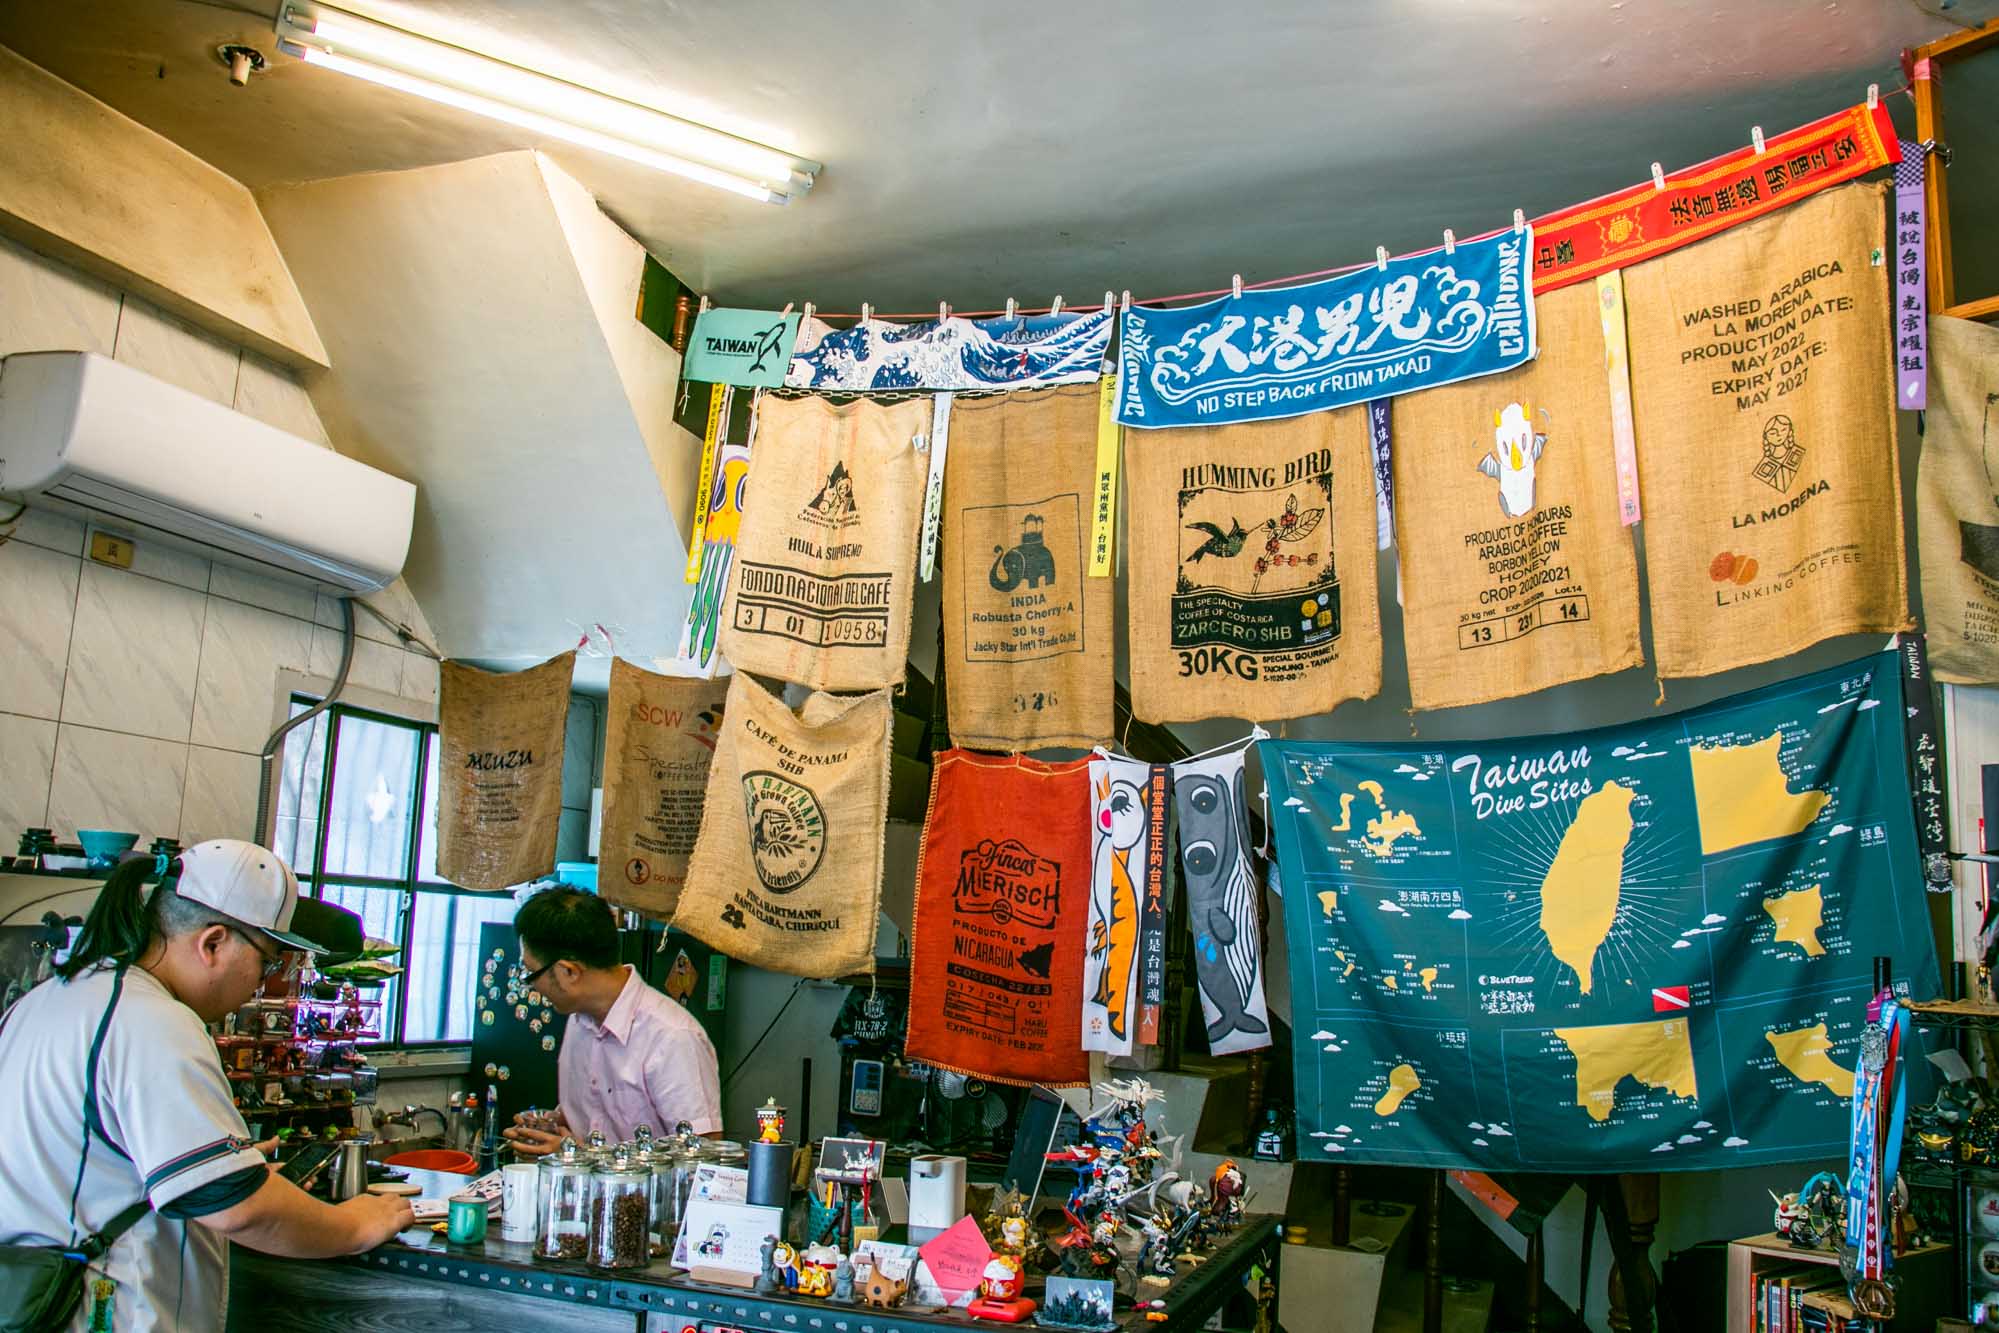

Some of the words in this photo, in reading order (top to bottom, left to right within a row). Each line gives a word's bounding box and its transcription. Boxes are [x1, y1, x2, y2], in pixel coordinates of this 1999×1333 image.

[1683, 299, 1761, 327] WASHED
[1769, 260, 1843, 307] ARABICA
[1193, 274, 1432, 376] 大港男兒
[1713, 322, 1737, 336] LA
[1745, 289, 1813, 332] MORENA
[706, 338, 757, 353] TAIWAN
[1681, 318, 1796, 364] PRODUCTION
[1801, 296, 1854, 324] DATE:
[1901, 295, 1923, 371] 光宗耀祖
[1712, 368, 1774, 395] EXPIRY
[1780, 340, 1828, 376] DATE:
[1732, 352, 1767, 373] MAY
[1772, 332, 1806, 360] 2022
[1196, 398, 1219, 416] NO
[1224, 389, 1266, 410] STEP
[1270, 380, 1316, 404] BACK
[1321, 373, 1373, 397] FROM
[1378, 355, 1432, 383] TAKAO
[1737, 388, 1770, 412] MAY
[1183, 463, 1275, 489] HUMMING
[1284, 449, 1332, 484] BIRD
[1733, 514, 1756, 529] LA
[1762, 479, 1830, 522] MORENA
[1465, 525, 1511, 547] PRODUCT
[1513, 523, 1526, 537] OF
[1527, 505, 1572, 528] HONDURAS
[1479, 540, 1527, 560] ARABICA
[1528, 522, 1567, 547] COFFEE
[788, 537, 822, 559] HUILA
[825, 544, 863, 561] SUPREMO
[1489, 555, 1527, 574] BORBON
[1528, 539, 1560, 562] YELLOW
[1800, 552, 1863, 578] COFFEE
[740, 567, 783, 595] FONDO
[786, 576, 844, 606] NACIONAL
[845, 582, 859, 605] DEL
[861, 579, 892, 605] CAFÉ
[1480, 585, 1517, 604] CROP
[1519, 566, 1570, 595] 2020/2021
[1500, 555, 1550, 584] HONEY
[744, 609, 753, 625] 3
[972, 613, 1022, 622] Robusta
[1011, 594, 1046, 607] INDIA
[1178, 609, 1210, 620] COFFEE
[1227, 611, 1256, 623] COSTA
[1257, 615, 1273, 623] RICA
[1180, 601, 1194, 609] THE
[1196, 598, 1243, 610] SPECIALTY
[1012, 627, 1026, 637] 30
[1031, 626, 1045, 636] kg
[1178, 620, 1257, 641] ZARCERO
[1261, 626, 1292, 642] SHB
[1472, 627, 1492, 642] 13
[1518, 613, 1533, 632] 231
[1560, 603, 1578, 618] 14
[974, 641, 998, 653] Jacky
[1001, 642, 1017, 652] Star
[1178, 647, 1258, 681] 30KG
[1263, 655, 1292, 663] SPECIAL
[1311, 653, 1339, 668] TAIWAN
[1904, 641, 1920, 680] TAIWAN
[638, 703, 683, 728] SCW
[745, 719, 778, 746] CAFÉ
[779, 743, 796, 758] DE
[797, 751, 848, 767] PANAMA
[777, 758, 804, 776] SHB
[1452, 745, 1591, 795] Taiwan
[1472, 793, 1525, 820] Dive
[1529, 777, 1592, 810] Sites
[977, 839, 1037, 876] Fincas
[1147, 768, 1165, 919] 一個堂堂正正的台灣人。
[952, 866, 1060, 915] MIERISCH
[1397, 890, 1462, 903] 澎湖南方四島
[762, 900, 822, 919] HARTMANN
[785, 917, 840, 931] CHIRIQUÍ
[952, 919, 1008, 940] PRODUCTO
[1012, 935, 1027, 945] DE
[953, 935, 1014, 971] NICARAGUA
[954, 966, 1004, 986] COSECHA
[946, 1022, 979, 1039] EXPIRY
